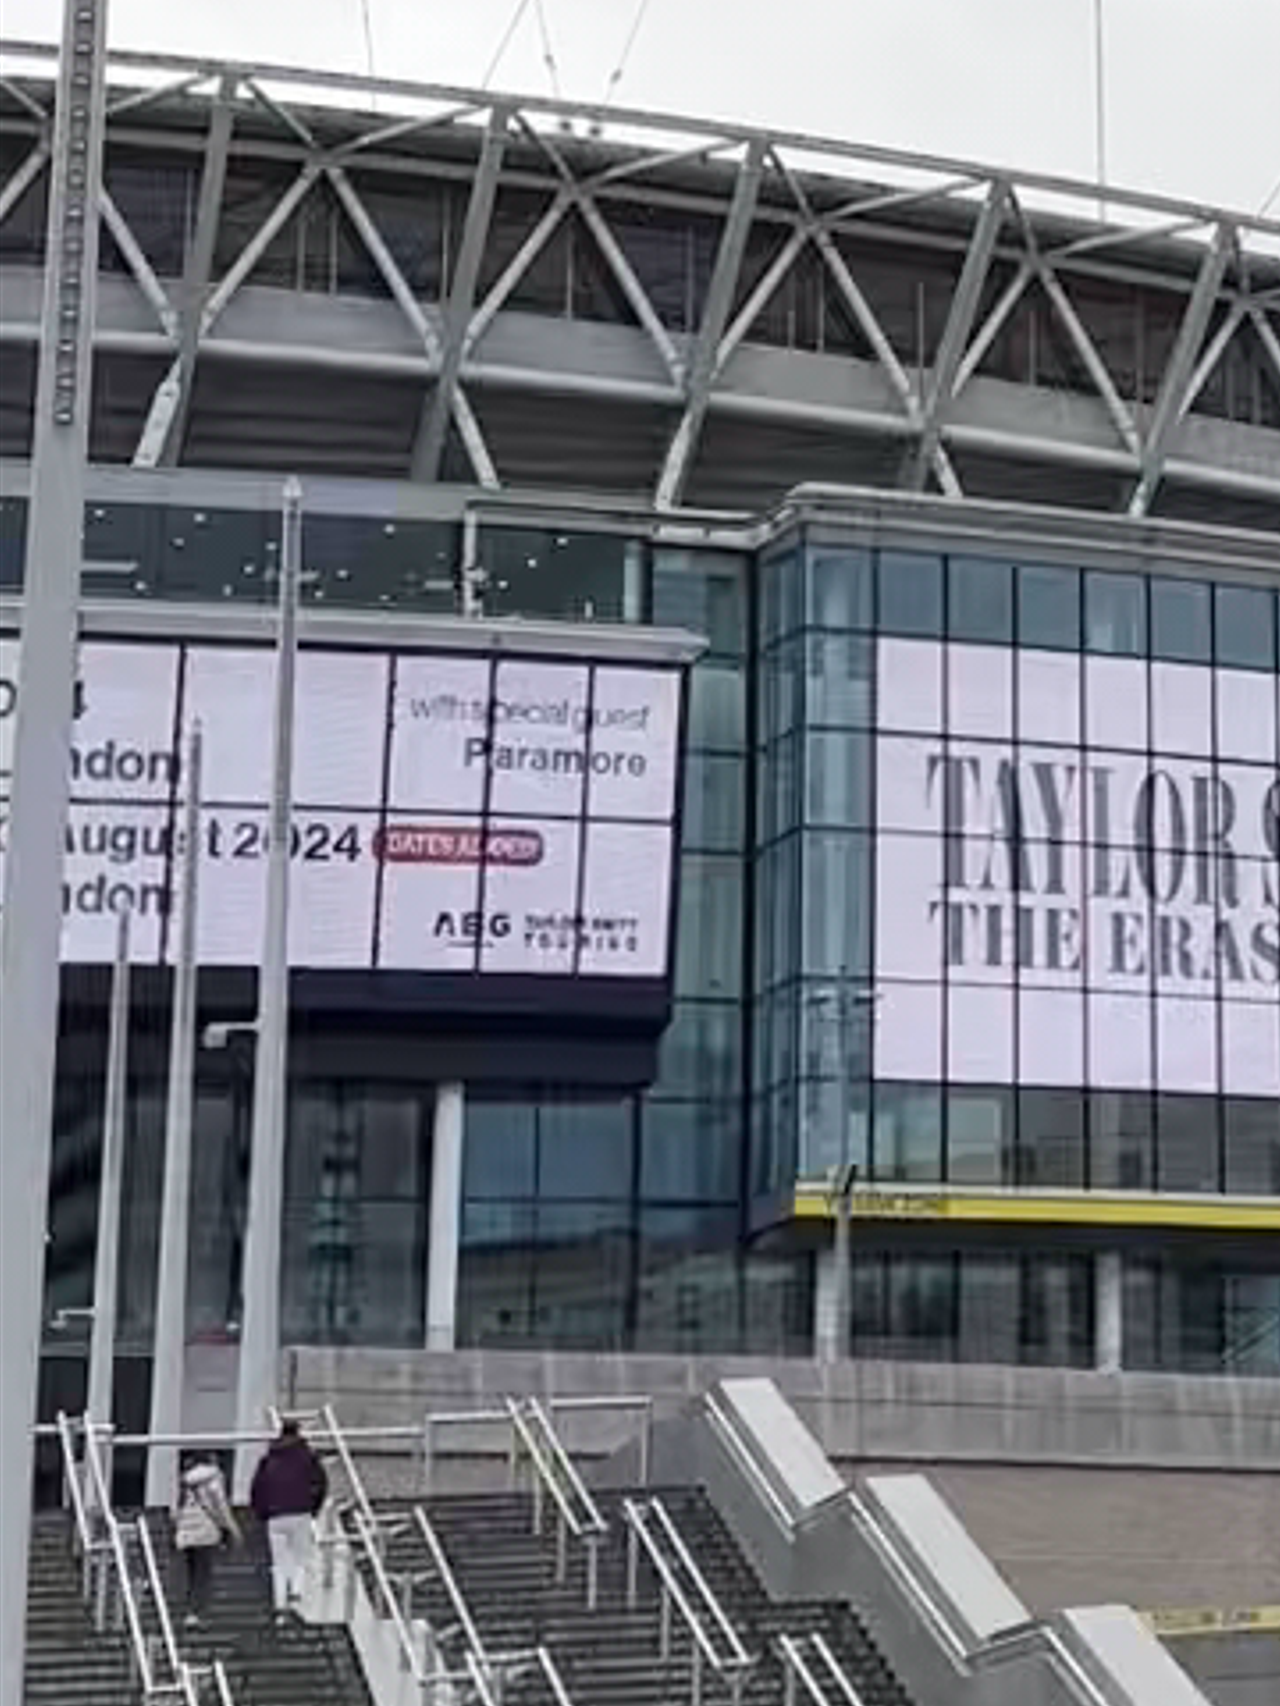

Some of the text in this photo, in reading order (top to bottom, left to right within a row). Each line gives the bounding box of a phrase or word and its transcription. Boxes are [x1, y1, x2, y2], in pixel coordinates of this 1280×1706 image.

[463, 738, 647, 776] Paramore
[926, 755, 1240, 908] TAYLOR
[433, 911, 511, 937] AEG
[929, 900, 1082, 970] THE
